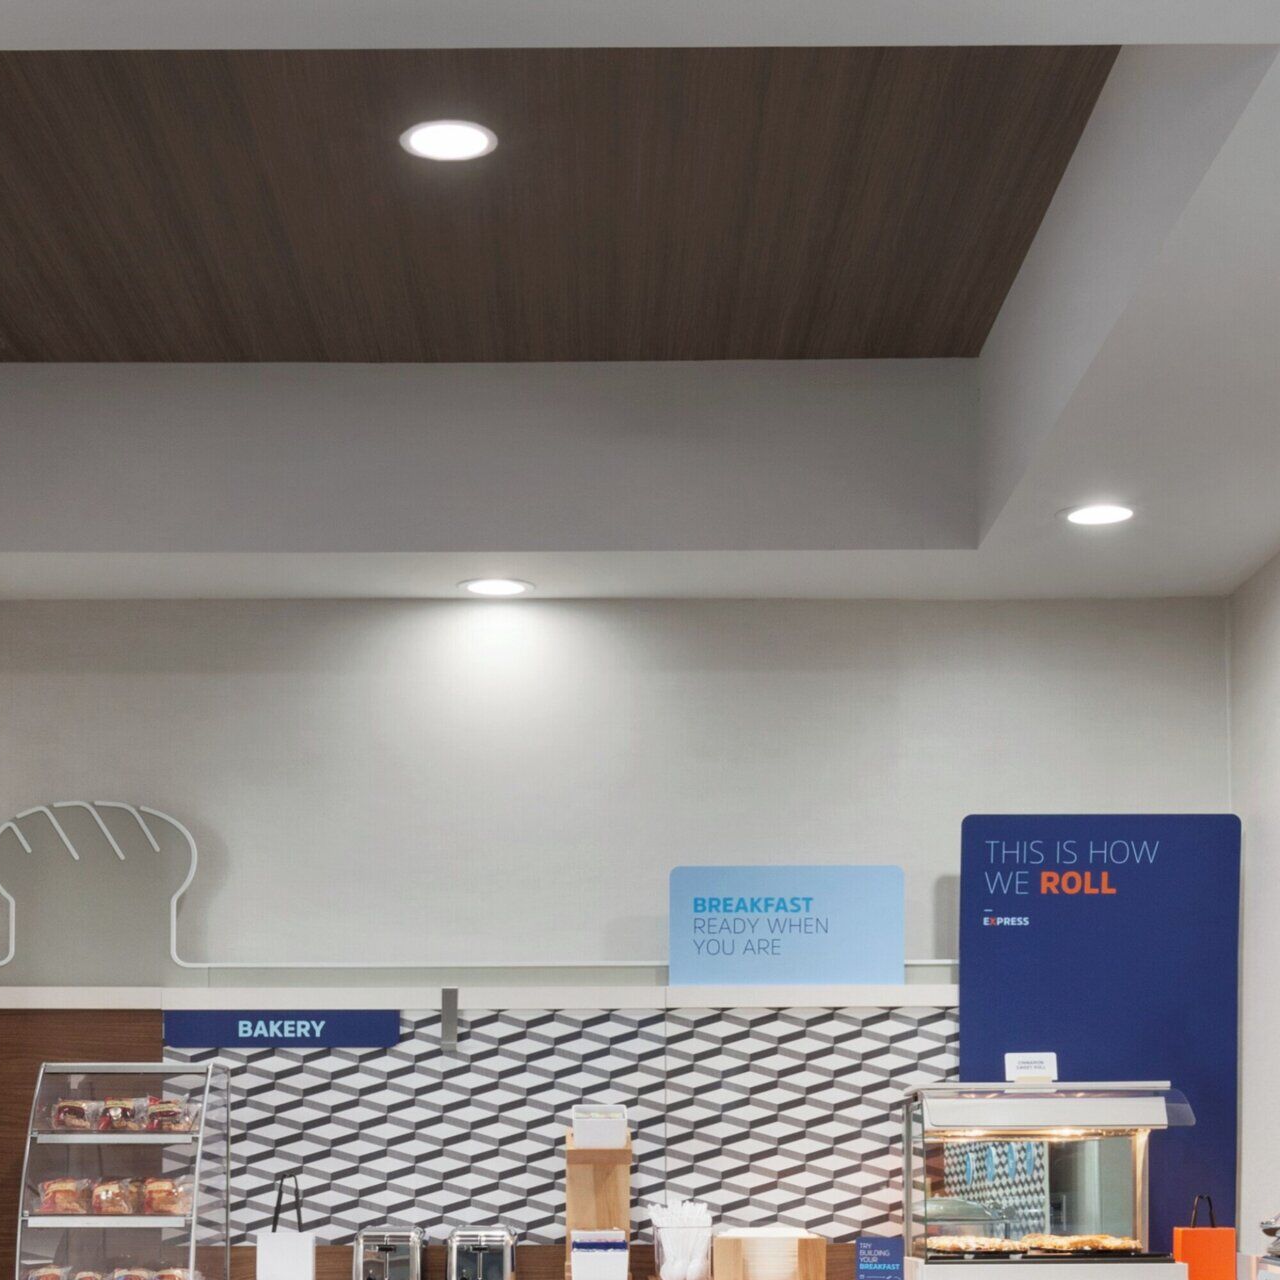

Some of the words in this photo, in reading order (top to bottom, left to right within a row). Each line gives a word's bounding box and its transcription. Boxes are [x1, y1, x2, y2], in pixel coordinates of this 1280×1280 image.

[985, 840, 1045, 864] THIS
[1056, 840, 1078, 864] IS
[1089, 840, 1160, 864] HOW
[985, 871, 1029, 895] WE
[1040, 871, 1117, 895] ROLL
[693, 897, 814, 913] BREAKFAST
[693, 917, 760, 935] READY
[767, 917, 829, 935] WHEN
[983, 916, 1030, 926] EXPRESS
[693, 938, 735, 956] YOU
[742, 938, 782, 956] ARE
[238, 1020, 326, 1037] BAKERY
